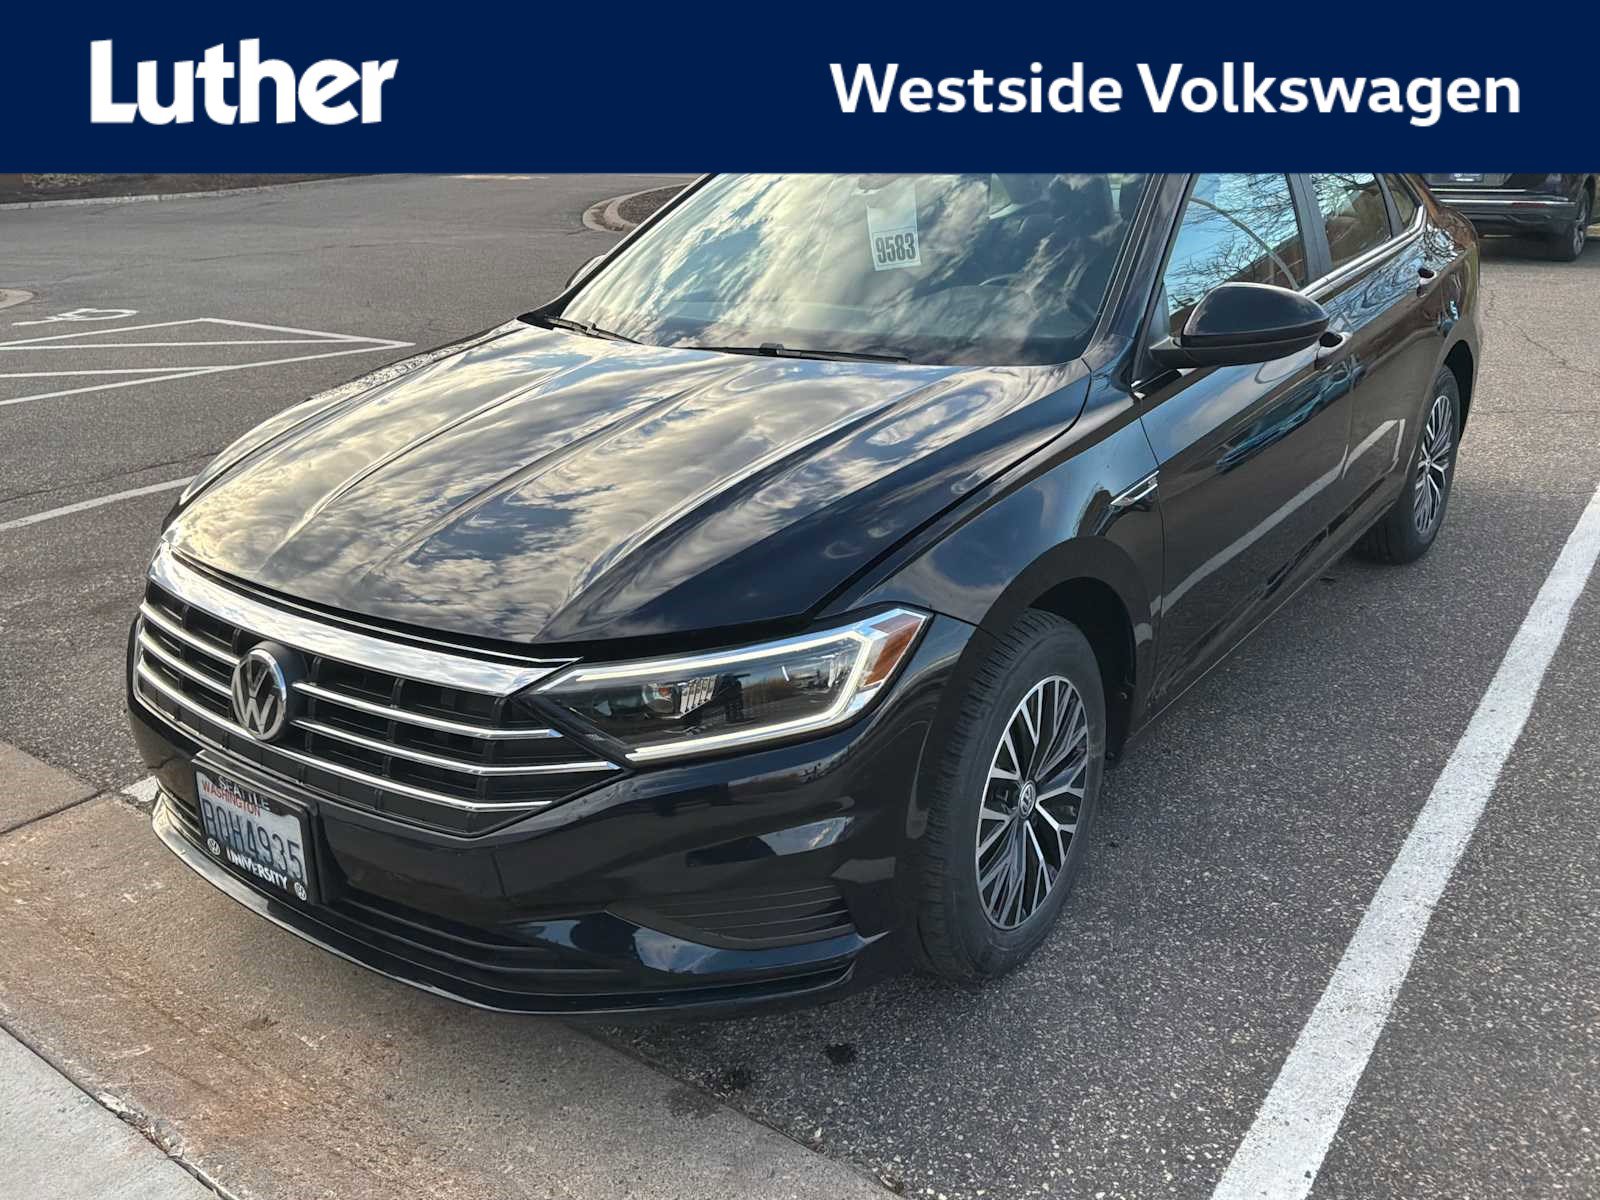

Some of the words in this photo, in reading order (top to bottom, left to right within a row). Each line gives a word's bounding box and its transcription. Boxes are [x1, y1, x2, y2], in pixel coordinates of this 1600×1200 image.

[875, 232, 917, 264] 9583
[201, 780, 261, 817] WASHINGTON
[226, 847, 288, 890] UNIVERSITY
